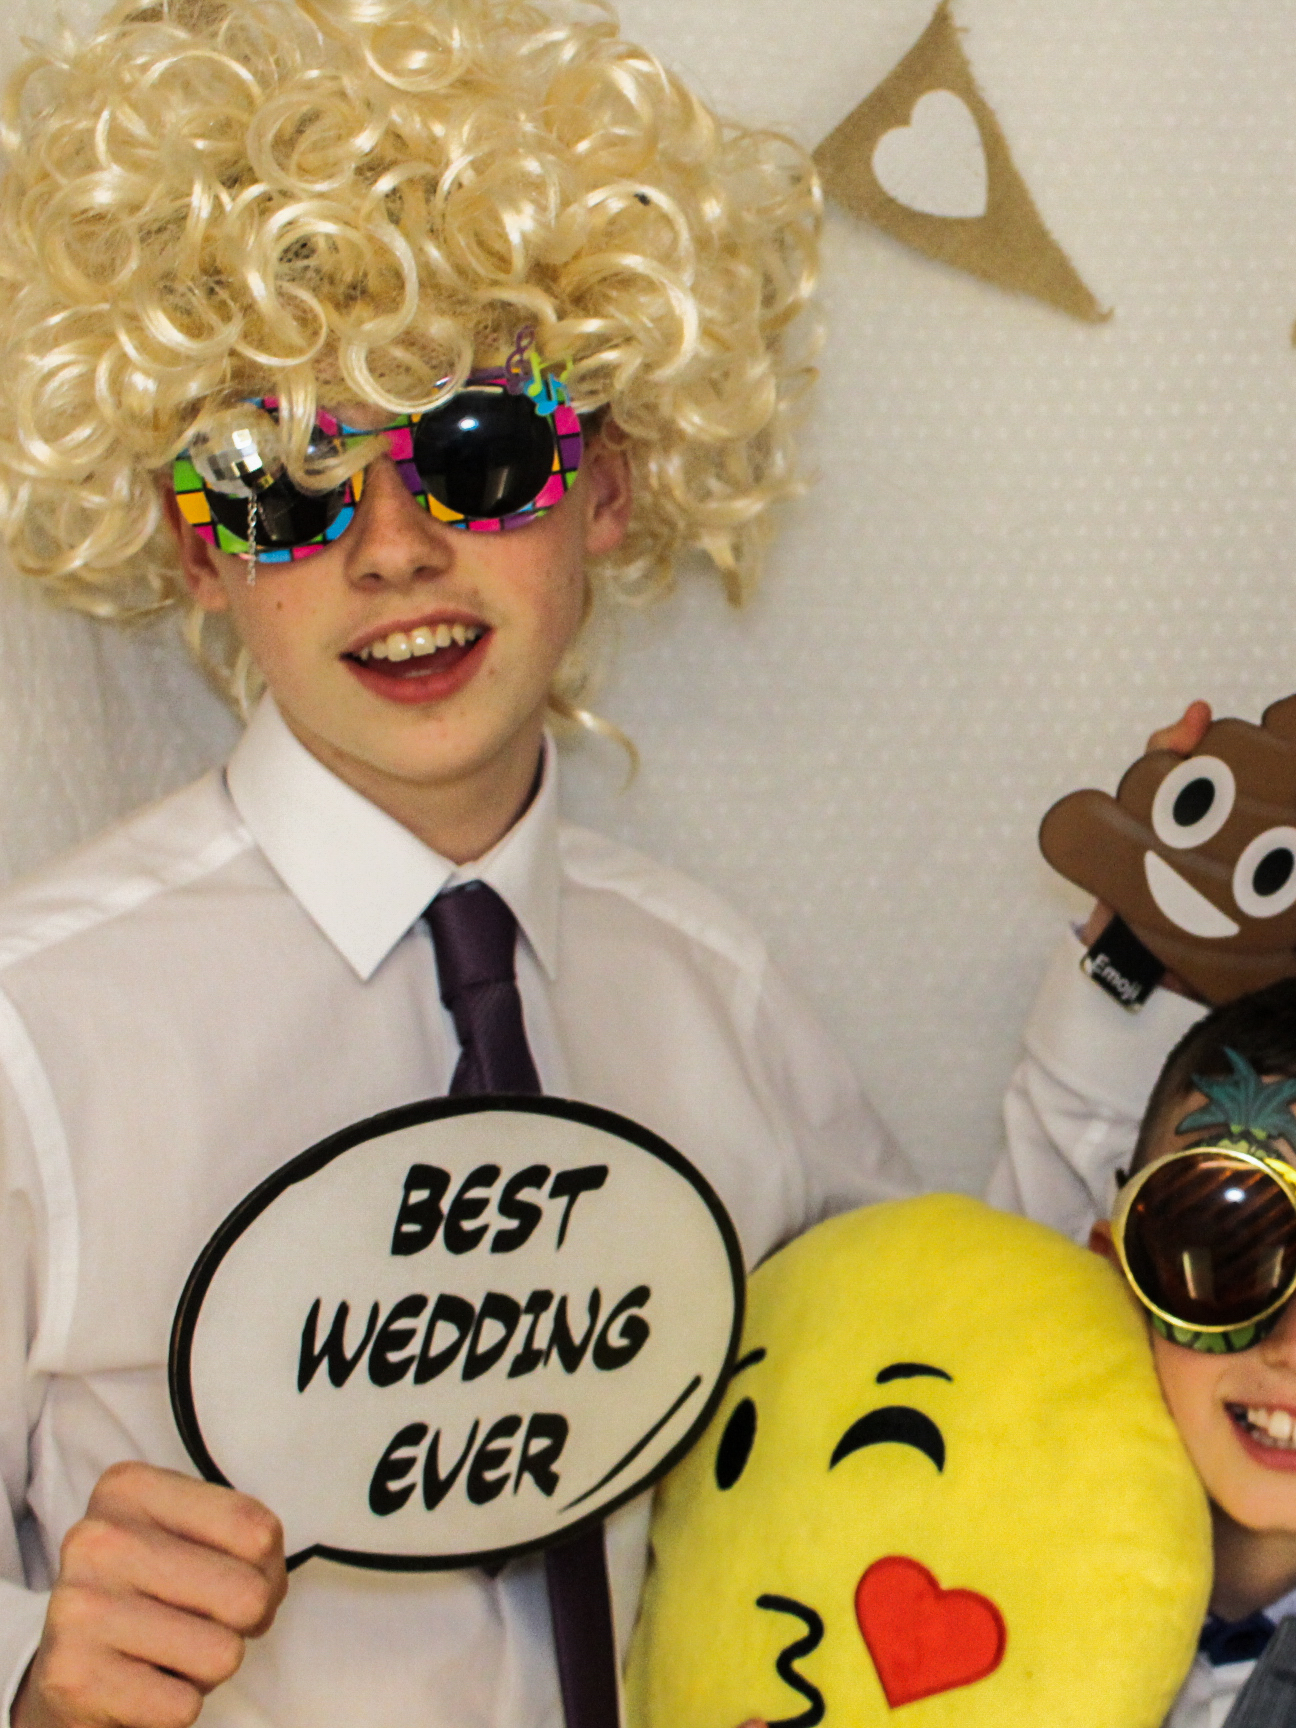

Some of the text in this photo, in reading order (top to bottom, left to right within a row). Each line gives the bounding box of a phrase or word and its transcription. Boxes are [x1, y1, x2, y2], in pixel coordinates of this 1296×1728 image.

[391, 1164, 608, 1256] BEST
[298, 1285, 651, 1393] WEDDING
[369, 1413, 568, 1516] EVER
